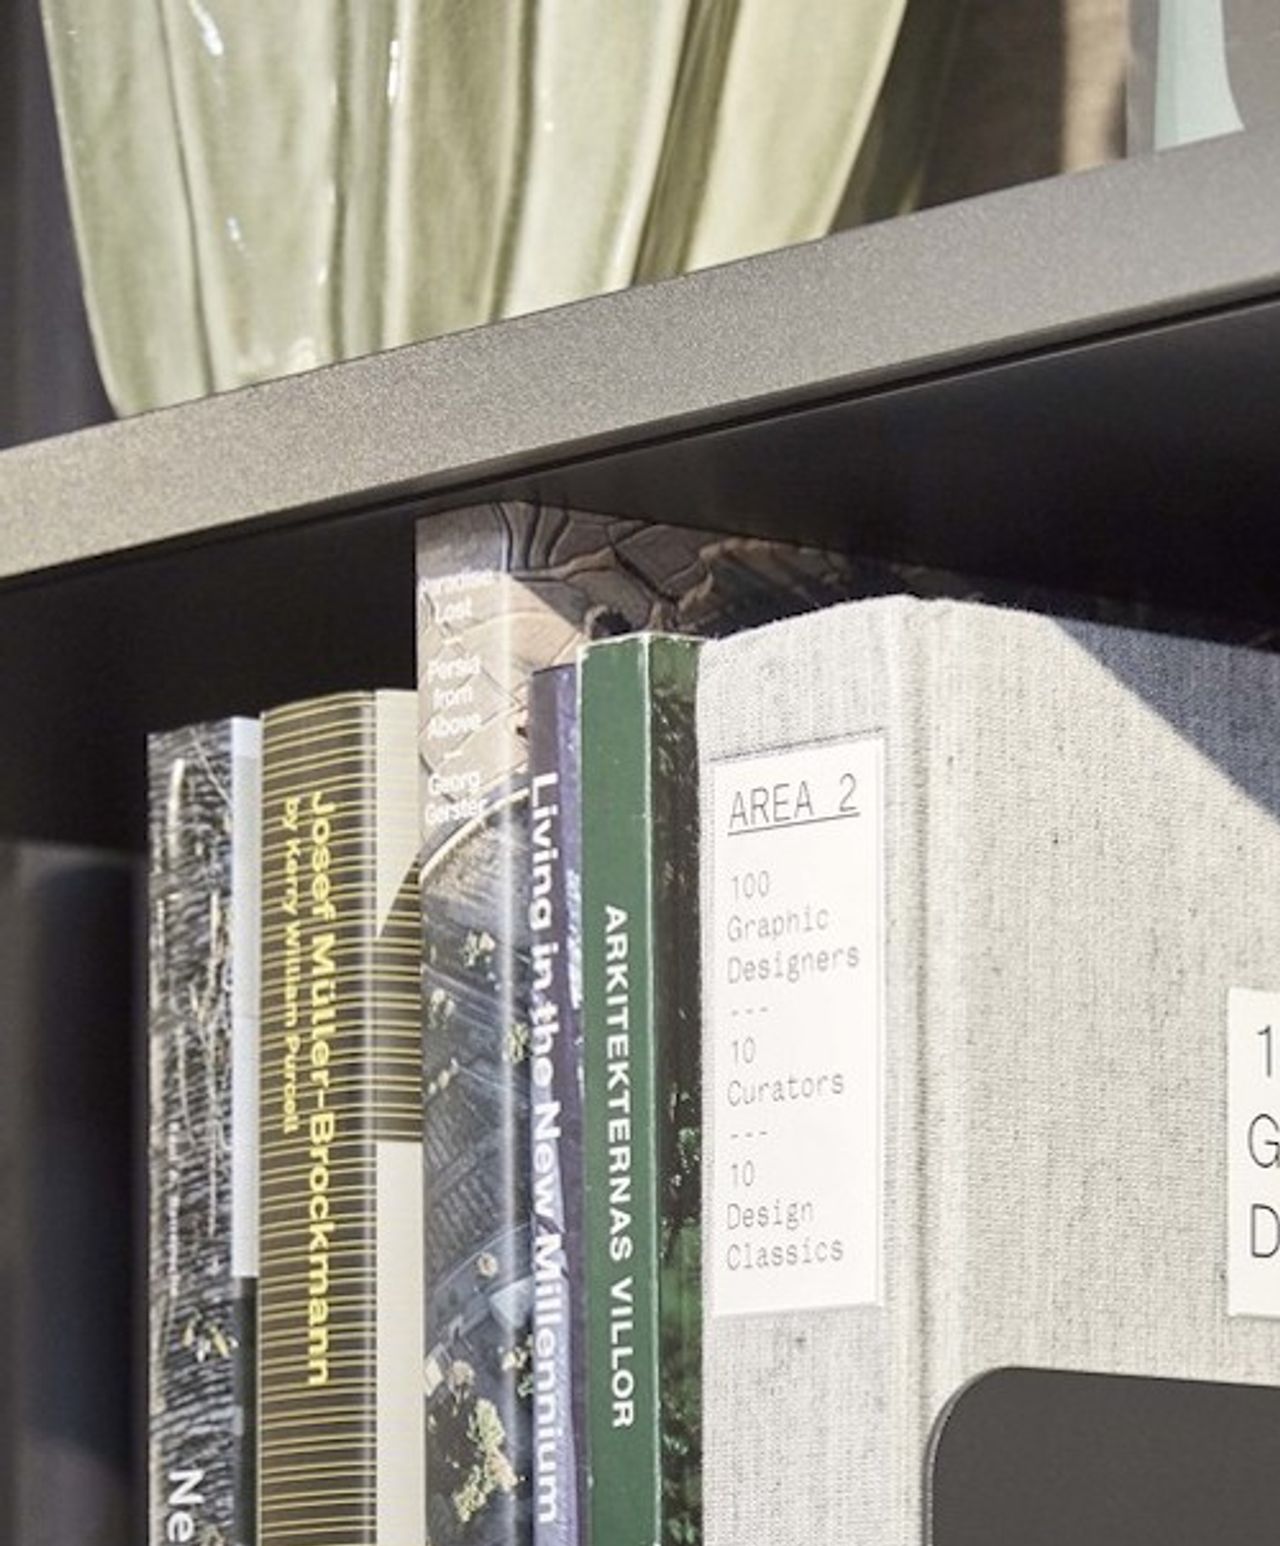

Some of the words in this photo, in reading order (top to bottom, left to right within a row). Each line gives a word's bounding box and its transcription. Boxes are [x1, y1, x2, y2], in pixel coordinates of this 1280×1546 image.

[729, 779, 814, 830] AREA
[838, 773, 858, 813] 2
[282, 838, 301, 916] Kerry
[311, 791, 338, 920] Josef
[528, 772, 560, 932] Living
[730, 869, 771, 901] 100
[726, 906, 830, 943] Graphic
[284, 920, 301, 1028] William
[530, 941, 560, 992] in
[726, 945, 861, 985] Designers
[528, 1001, 560, 1088] the
[604, 904, 634, 1262] ARKITEKTERNAS
[730, 1037, 756, 1066] 10
[283, 1034, 301, 1135] Purcell
[726, 1071, 845, 1108] Curators
[306, 932, 338, 1387] Müller-Brockmann
[531, 1100, 562, 1218] New
[730, 1159, 756, 1189] 10
[726, 1198, 814, 1232] Design
[726, 1235, 844, 1272] Classics
[535, 1233, 563, 1524] Millennium
[610, 1276, 635, 1429] VILLOR
